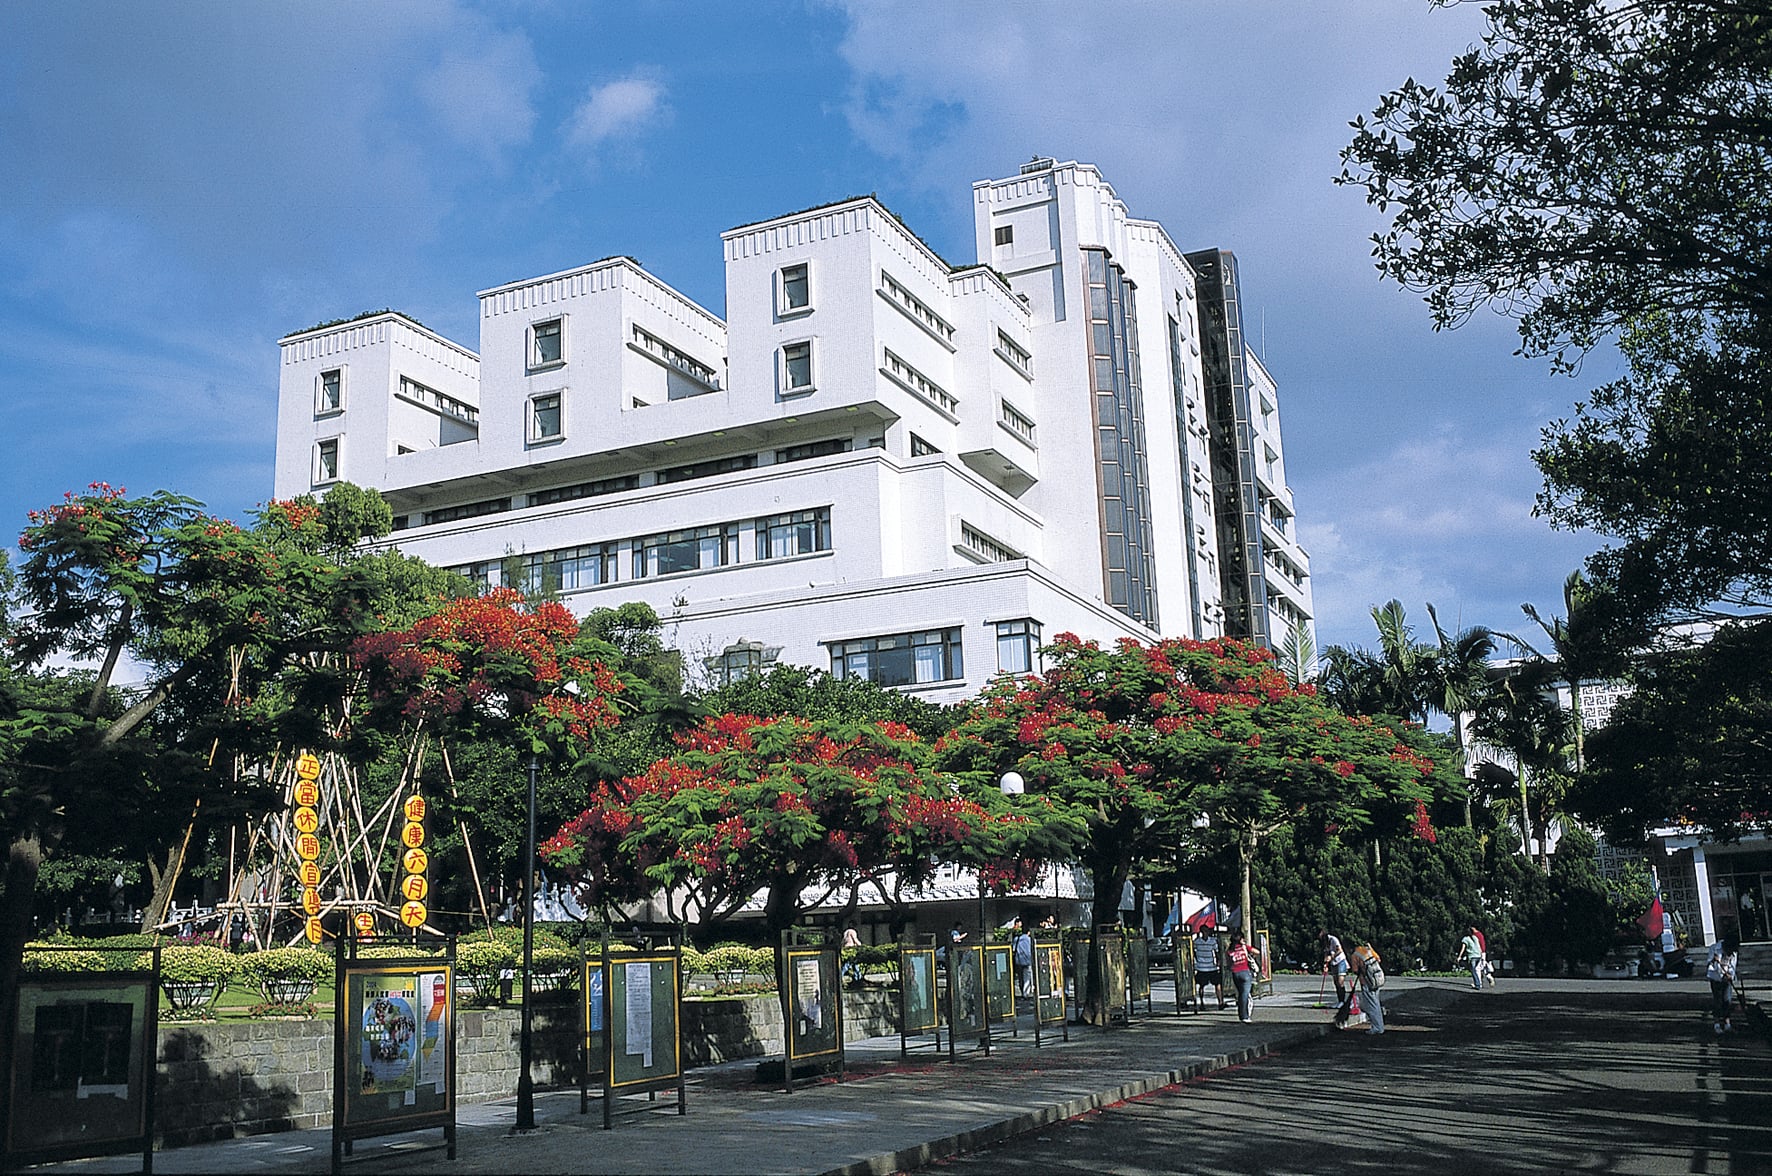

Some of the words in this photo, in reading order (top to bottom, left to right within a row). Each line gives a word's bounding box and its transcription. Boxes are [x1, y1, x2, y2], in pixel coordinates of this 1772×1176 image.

[405, 799, 426, 925] 健康六月天
